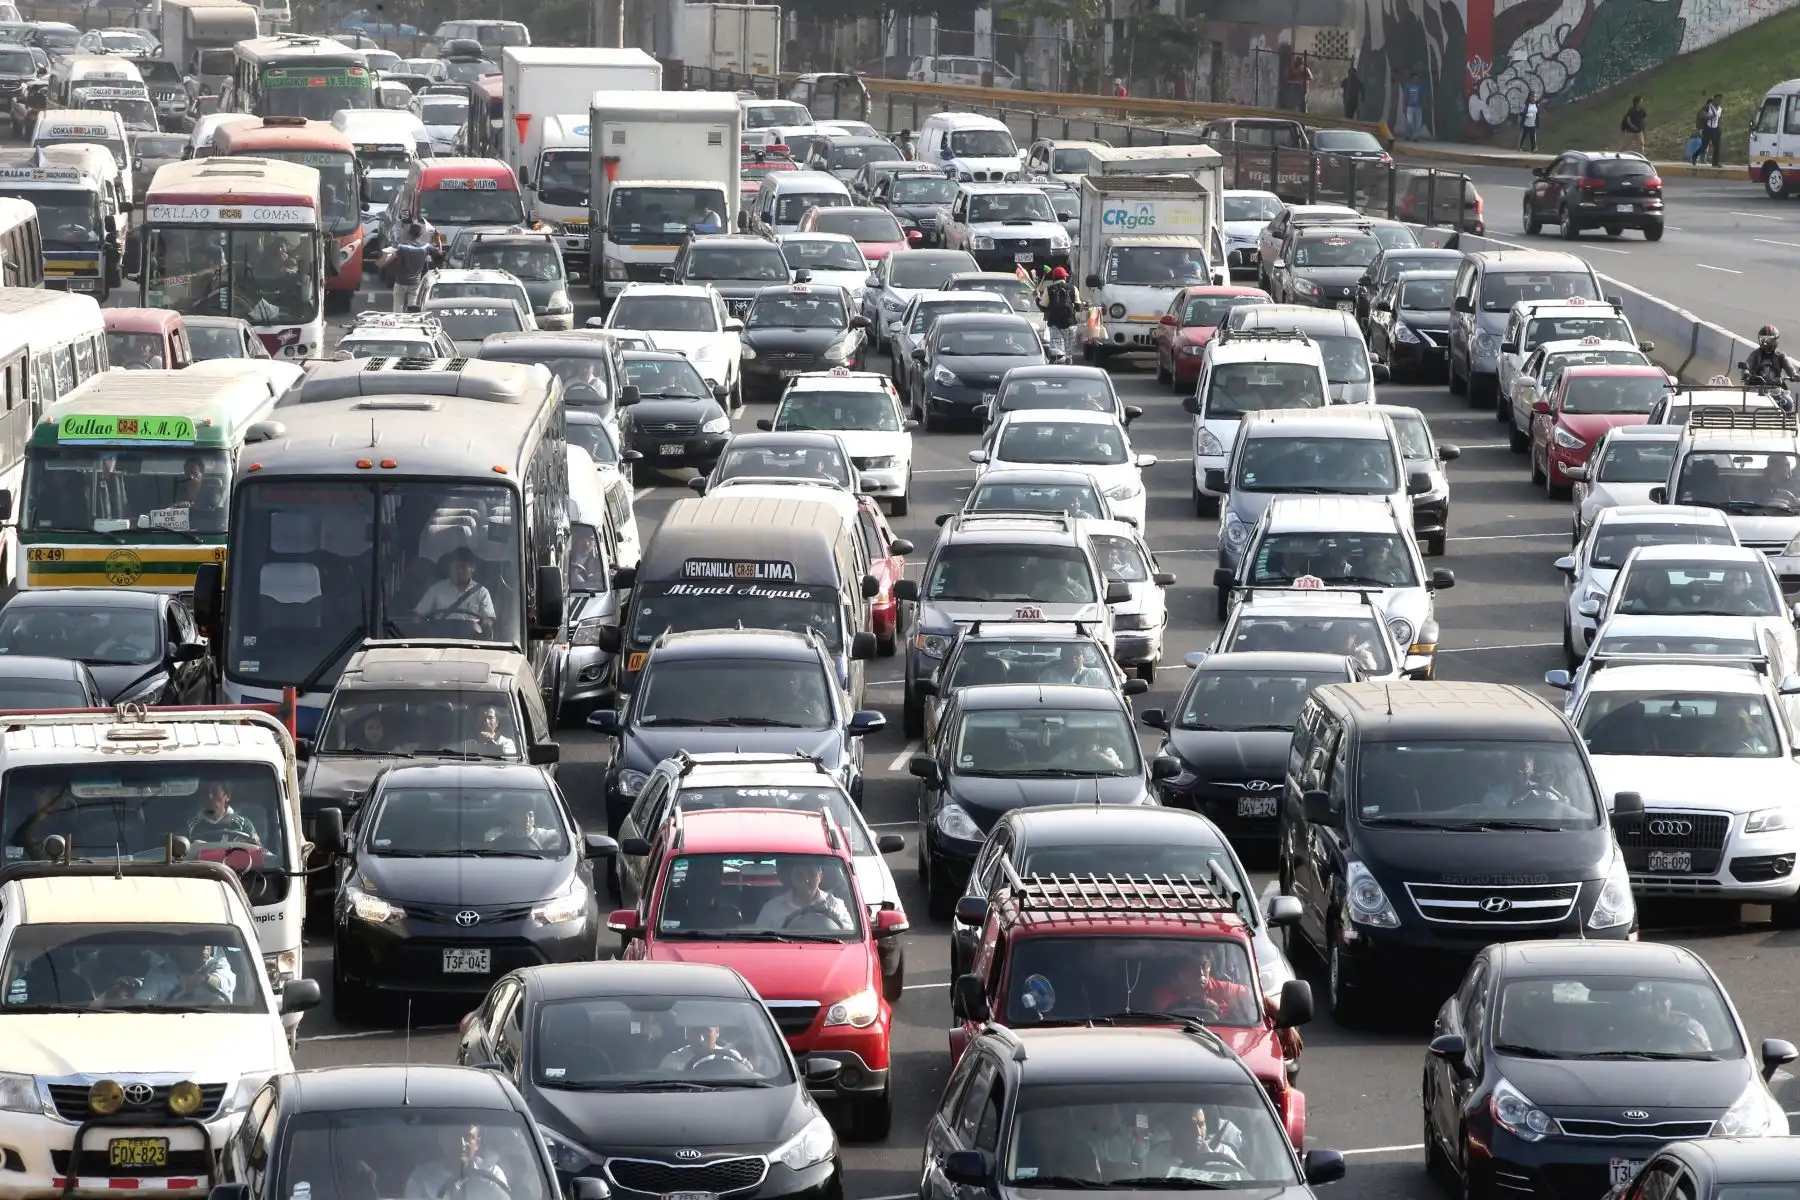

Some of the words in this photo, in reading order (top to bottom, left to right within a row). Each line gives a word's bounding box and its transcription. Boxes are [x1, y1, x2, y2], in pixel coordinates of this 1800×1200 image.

[52, 127, 73, 135] COMAS
[301, 155, 331, 165] SURCO
[0, 170, 30, 178] CALLAO
[1248, 171, 1309, 184] Maindra
[153, 206, 209, 219] CALLAO
[253, 209, 299, 220] COMAS
[1103, 209, 1156, 230] CRgas
[832, 369, 849, 377] TAXI
[1711, 378, 1729, 386] TAXI
[64, 418, 113, 435] Callao
[118, 419, 138, 434] CR-49
[140, 419, 151, 435] S.
[155, 421, 170, 435] M.
[153, 510, 186, 518] FUERA
[28, 549, 62, 561] CR-49
[685, 561, 734, 578] VENTANILLA
[755, 563, 793, 579] LIMA
[1296, 577, 1320, 588] TAXI
[663, 584, 735, 597] Miguel
[737, 584, 812, 600] Augusto
[1015, 608, 1040, 619] TAXI
[278, 911, 284, 921] 5
[445, 955, 488, 969] T3F-045
[112, 1146, 165, 1163] FOX-823
